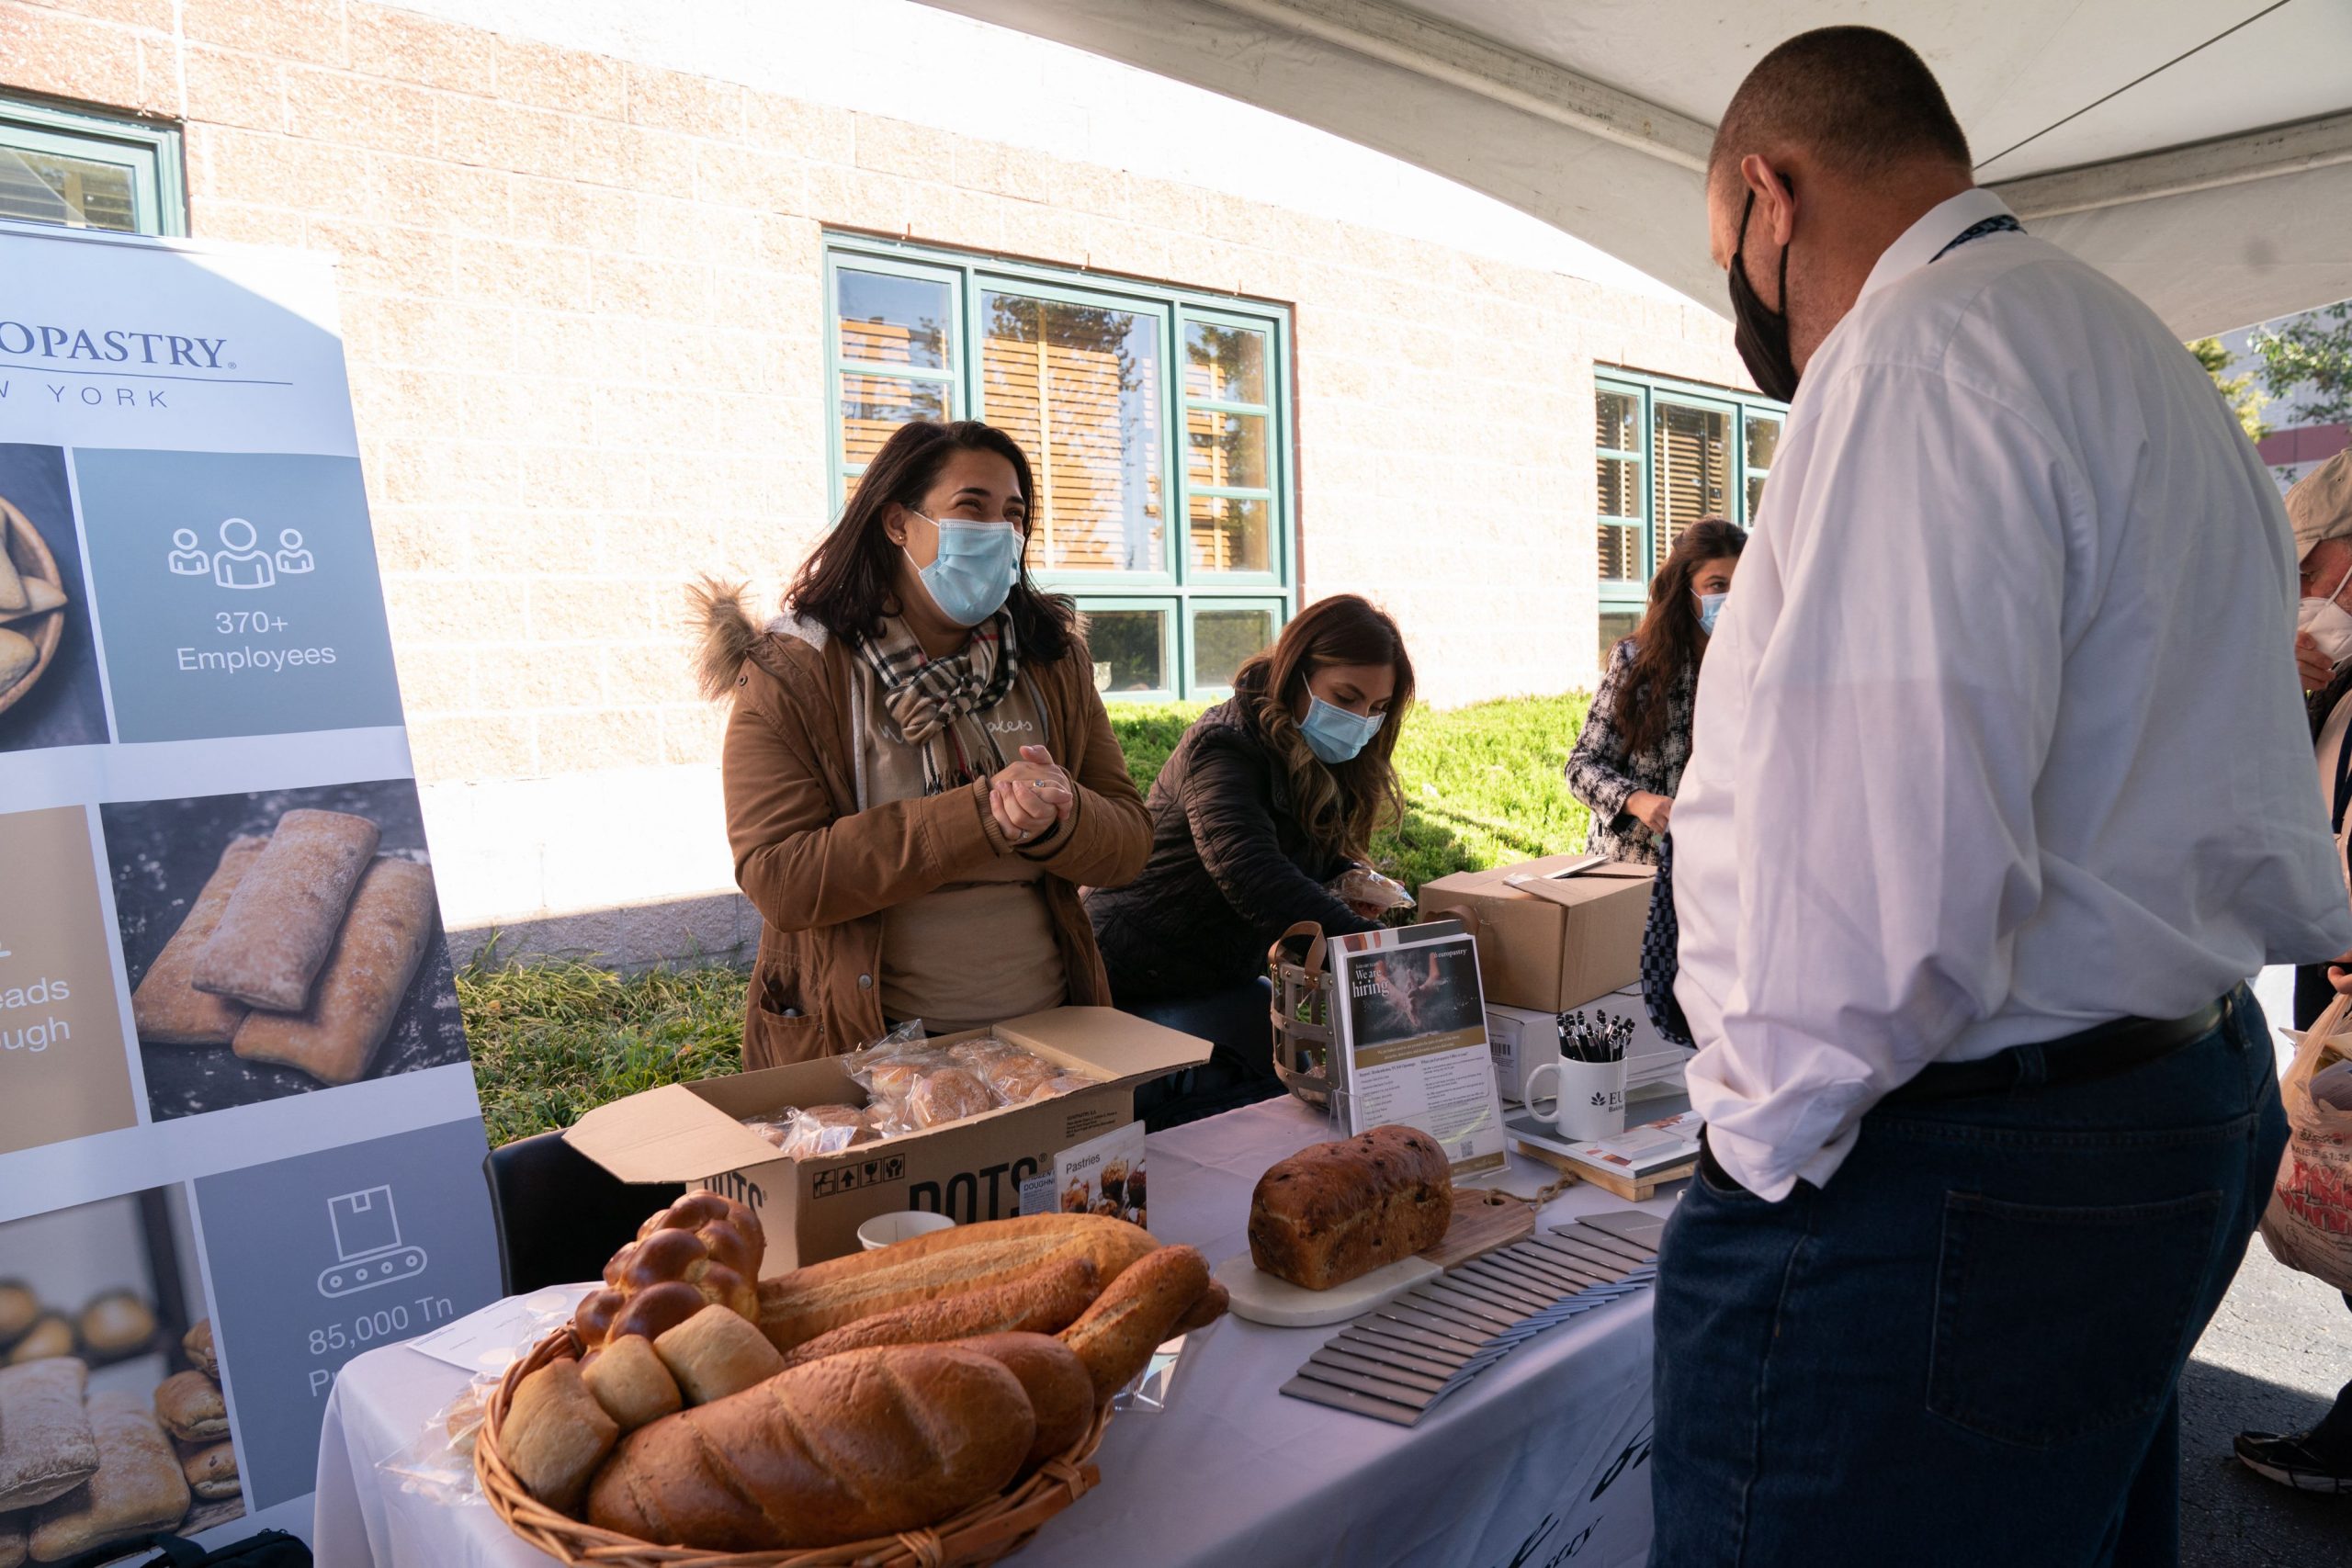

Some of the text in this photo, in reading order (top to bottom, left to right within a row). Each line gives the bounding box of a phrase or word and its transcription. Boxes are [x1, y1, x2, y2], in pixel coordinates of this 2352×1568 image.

[47, 384, 168, 408] YORK
[215, 612, 288, 634] 370+
[177, 646, 336, 673] Employees
[987, 713, 1033, 733] akers
[1355, 969, 1382, 980] We are
[0, 977, 70, 1009] ads
[1352, 979, 1390, 998] hiring
[0, 1017, 70, 1052] ugh
[1066, 1154, 1101, 1174] Pastries
[309, 1304, 409, 1355] 85,000
[414, 1296, 454, 1322] Tn
